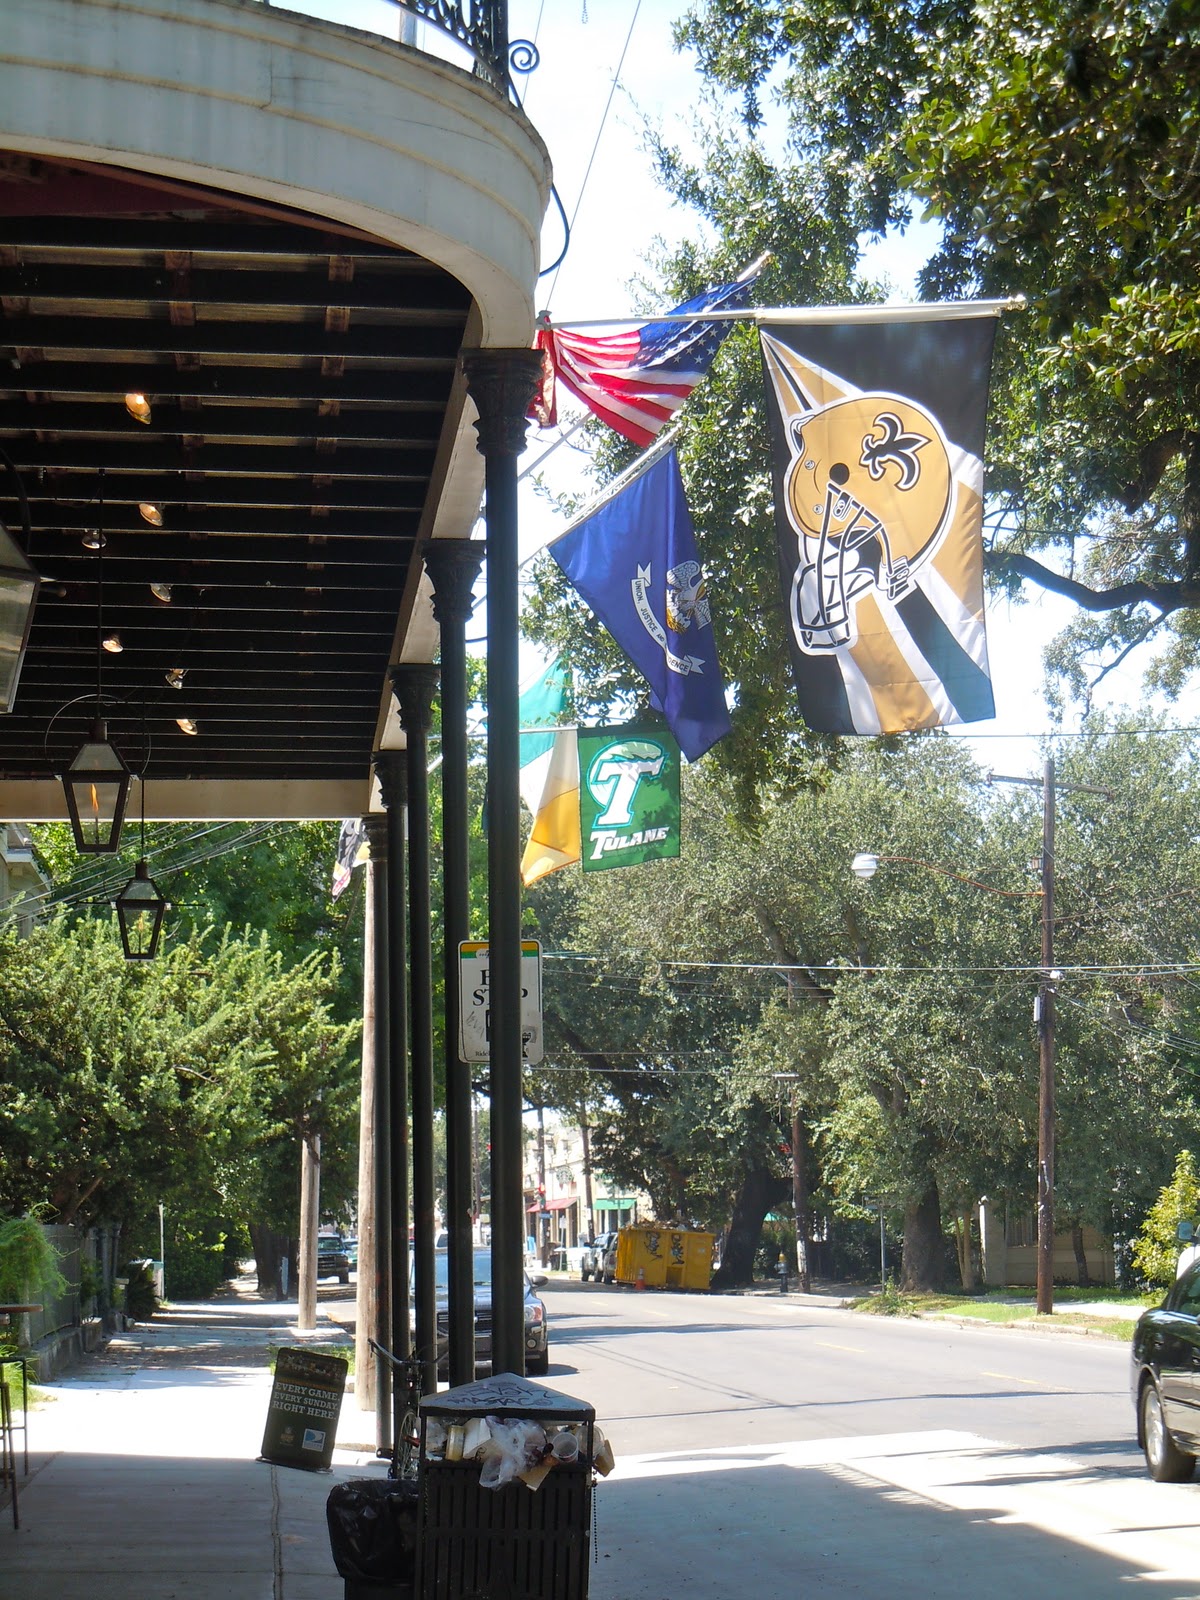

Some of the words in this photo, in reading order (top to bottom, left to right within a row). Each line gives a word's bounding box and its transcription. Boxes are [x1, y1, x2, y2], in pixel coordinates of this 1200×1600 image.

[641, 608, 658, 632] JUSTICE
[656, 634, 665, 642] AND
[590, 827, 669, 860] TULANE
[273, 1391, 303, 1404] EVERY
[303, 1397, 338, 1410] SUNDAY.
[275, 1382, 308, 1395] EVERY
[308, 1388, 340, 1401] GAME.
[272, 1400, 306, 1414] RIGHT
[306, 1407, 337, 1420] HERE.
